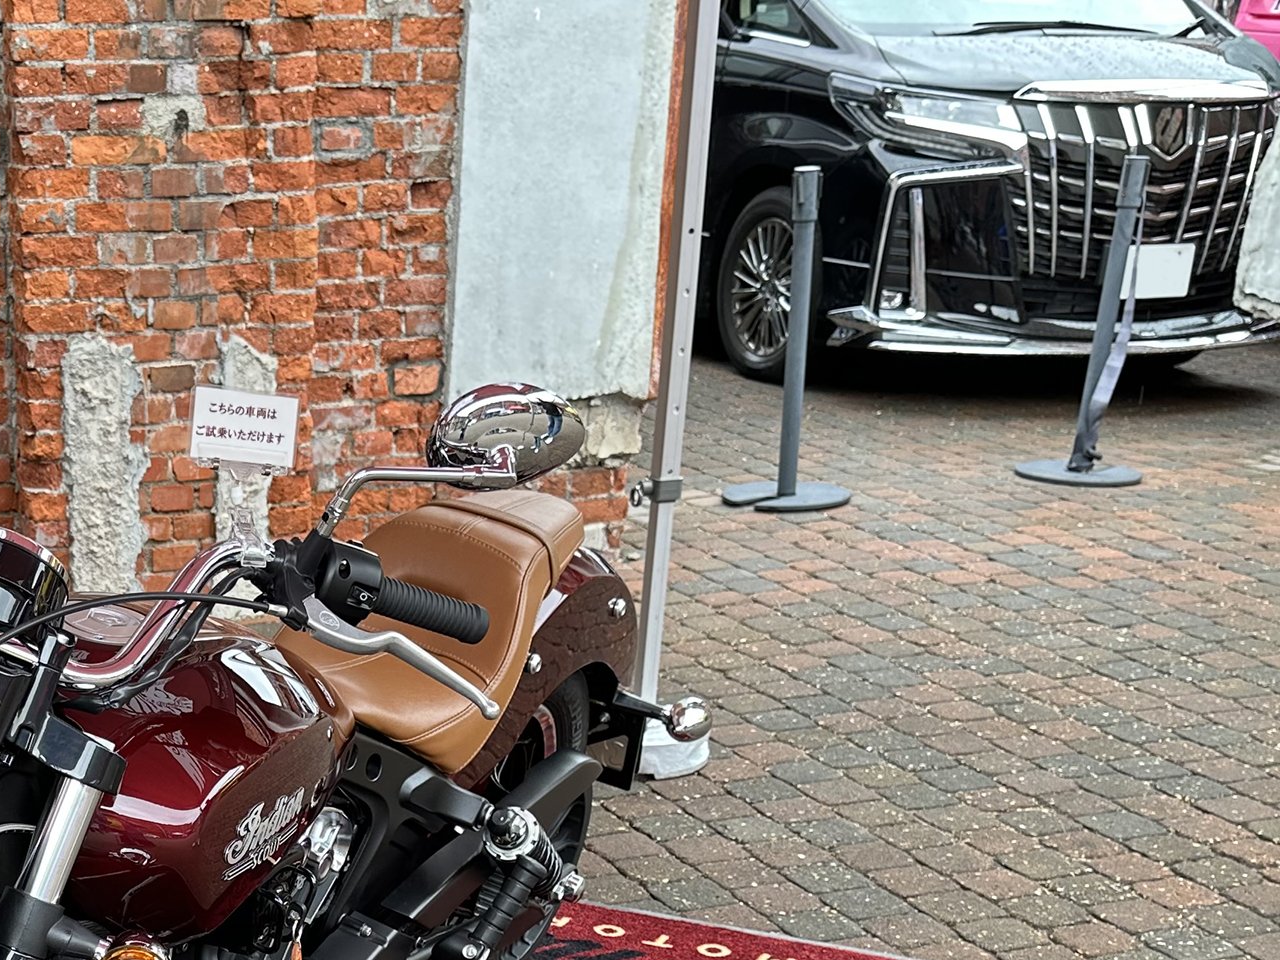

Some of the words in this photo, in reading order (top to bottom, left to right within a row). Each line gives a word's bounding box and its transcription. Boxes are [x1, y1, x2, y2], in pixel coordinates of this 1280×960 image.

[209, 402, 277, 419] こちらの車両は
[196, 425, 285, 445] ご試乗いただけます
[224, 787, 304, 865] Indian
